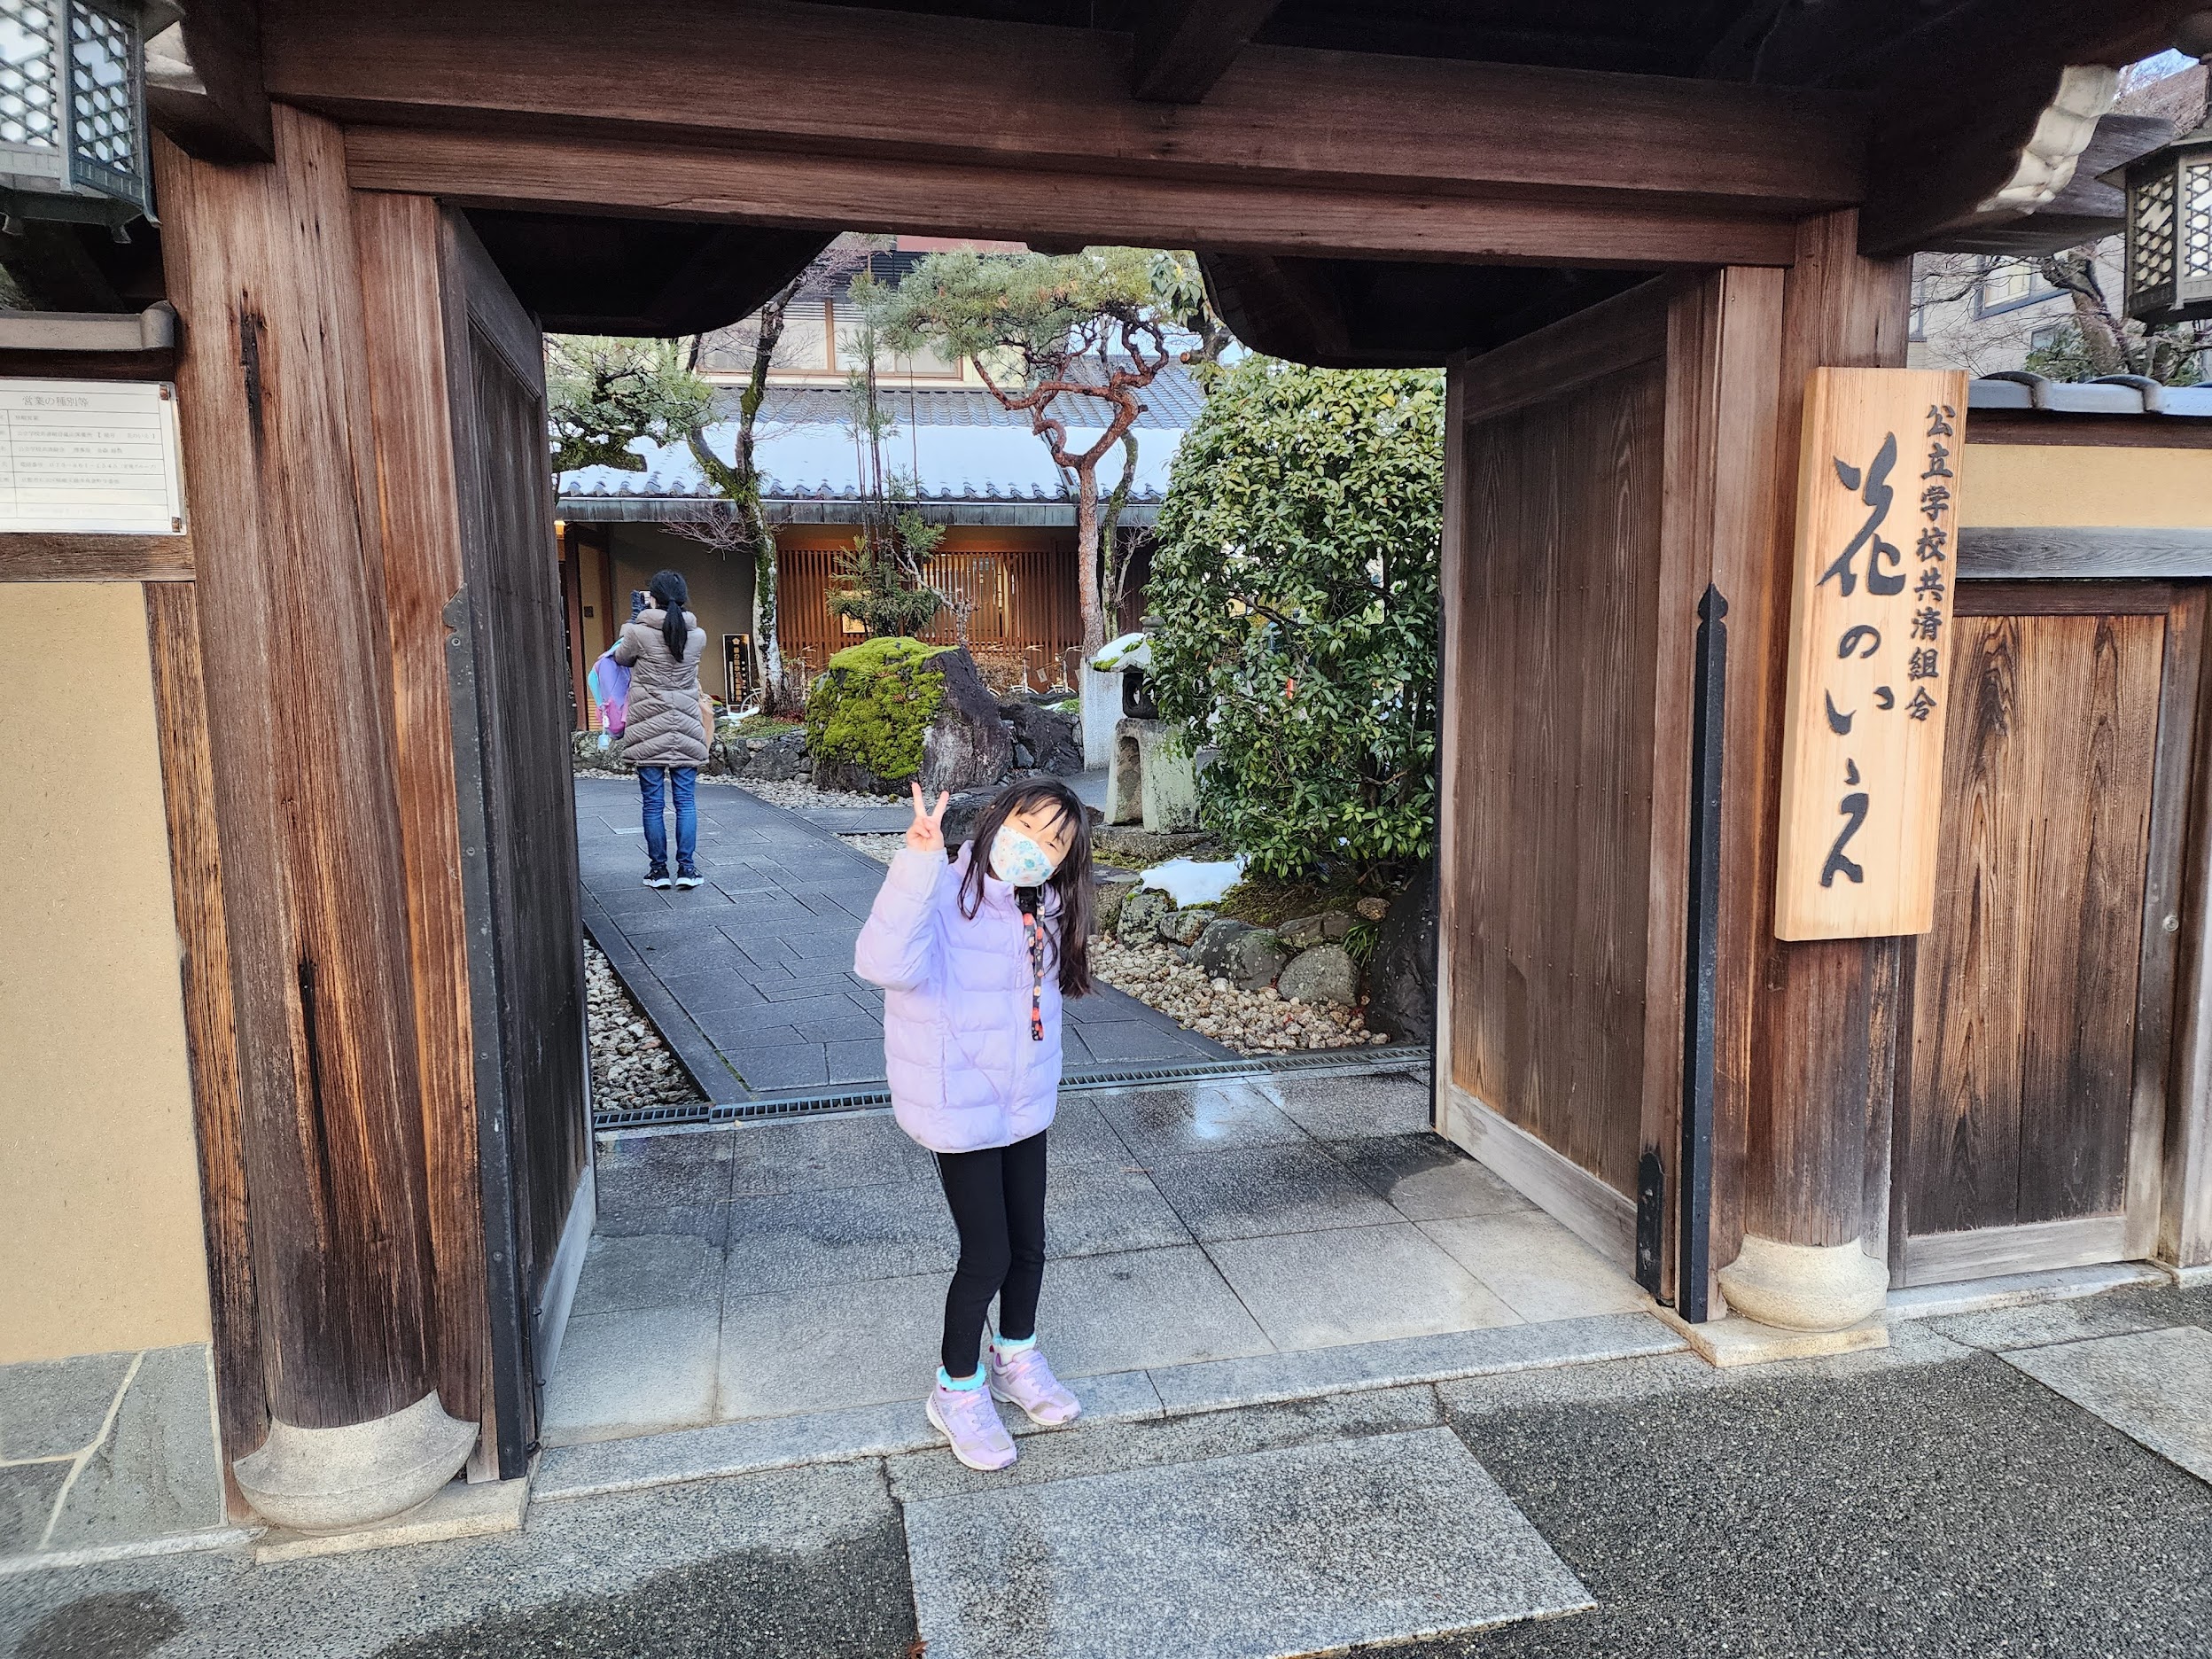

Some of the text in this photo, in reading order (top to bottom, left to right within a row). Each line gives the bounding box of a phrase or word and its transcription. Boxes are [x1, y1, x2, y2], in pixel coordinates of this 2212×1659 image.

[22, 395, 90, 408] 営業の種別等
[1815, 431, 1907, 888] 花のいえ
[1904, 404, 1957, 721] 公立学校共済組合
